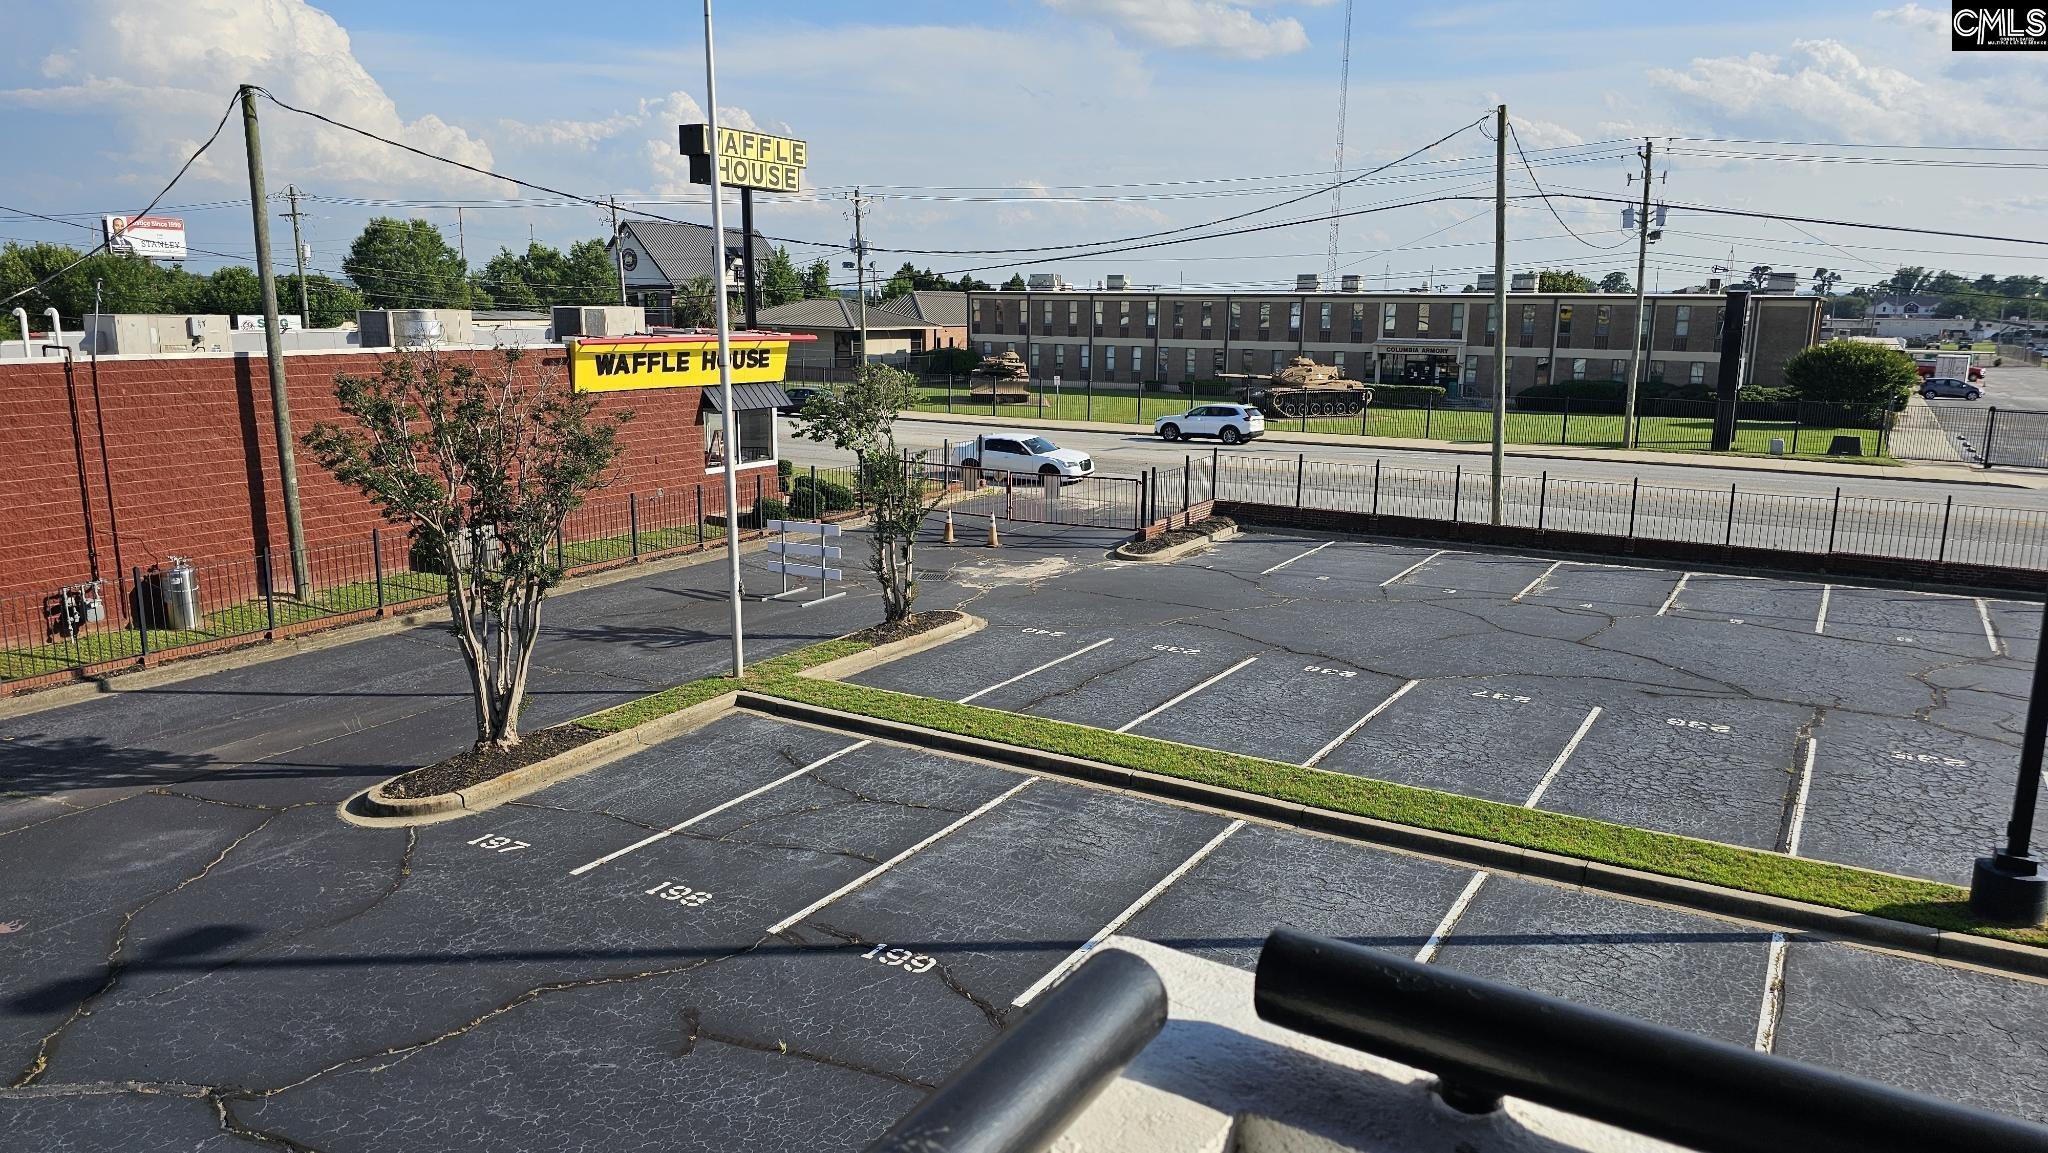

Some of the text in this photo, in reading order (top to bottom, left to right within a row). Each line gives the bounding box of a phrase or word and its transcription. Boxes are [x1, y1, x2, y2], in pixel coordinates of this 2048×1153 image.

[141, 240, 180, 249] STANLEY
[595, 351, 690, 376] WAFFLE
[1152, 643, 1201, 655] 239
[1303, 664, 1358, 678] 238
[1471, 690, 1532, 704] 237
[1666, 717, 1731, 733] 236
[1890, 750, 1968, 767] 235
[467, 833, 532, 853] 197
[644, 881, 713, 907] 198
[860, 943, 938, 974] 199
